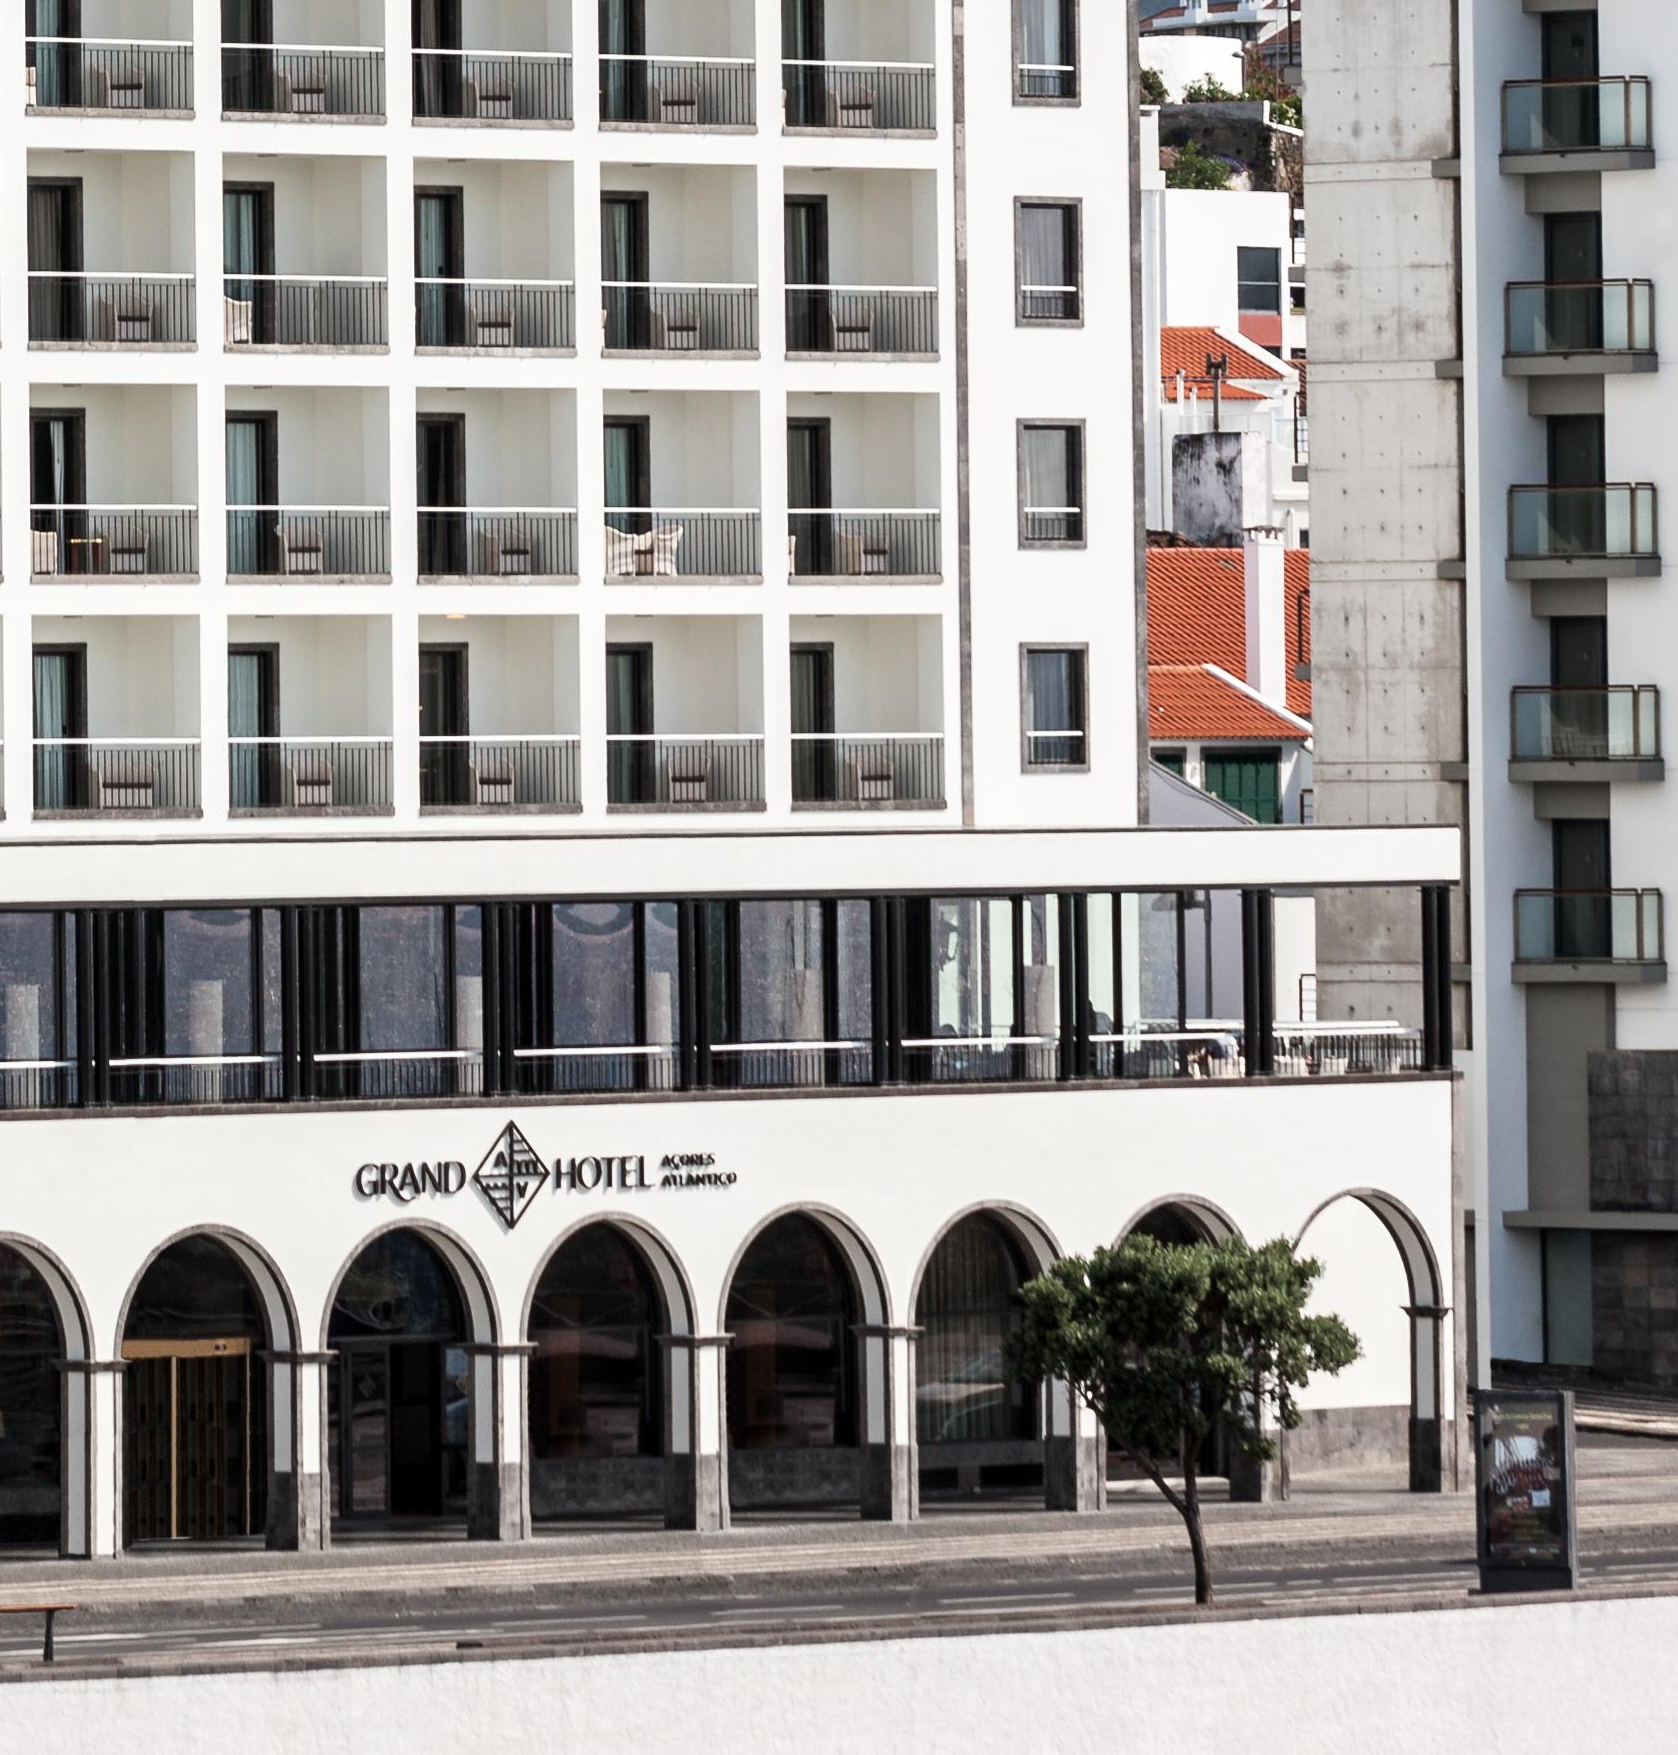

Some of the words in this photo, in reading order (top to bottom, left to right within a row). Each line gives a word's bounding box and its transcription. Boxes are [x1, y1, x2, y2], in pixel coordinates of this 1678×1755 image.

[661, 1154, 715, 1170] AÇORES
[356, 1161, 467, 1203] GRAND
[555, 1155, 653, 1190] HOTEL
